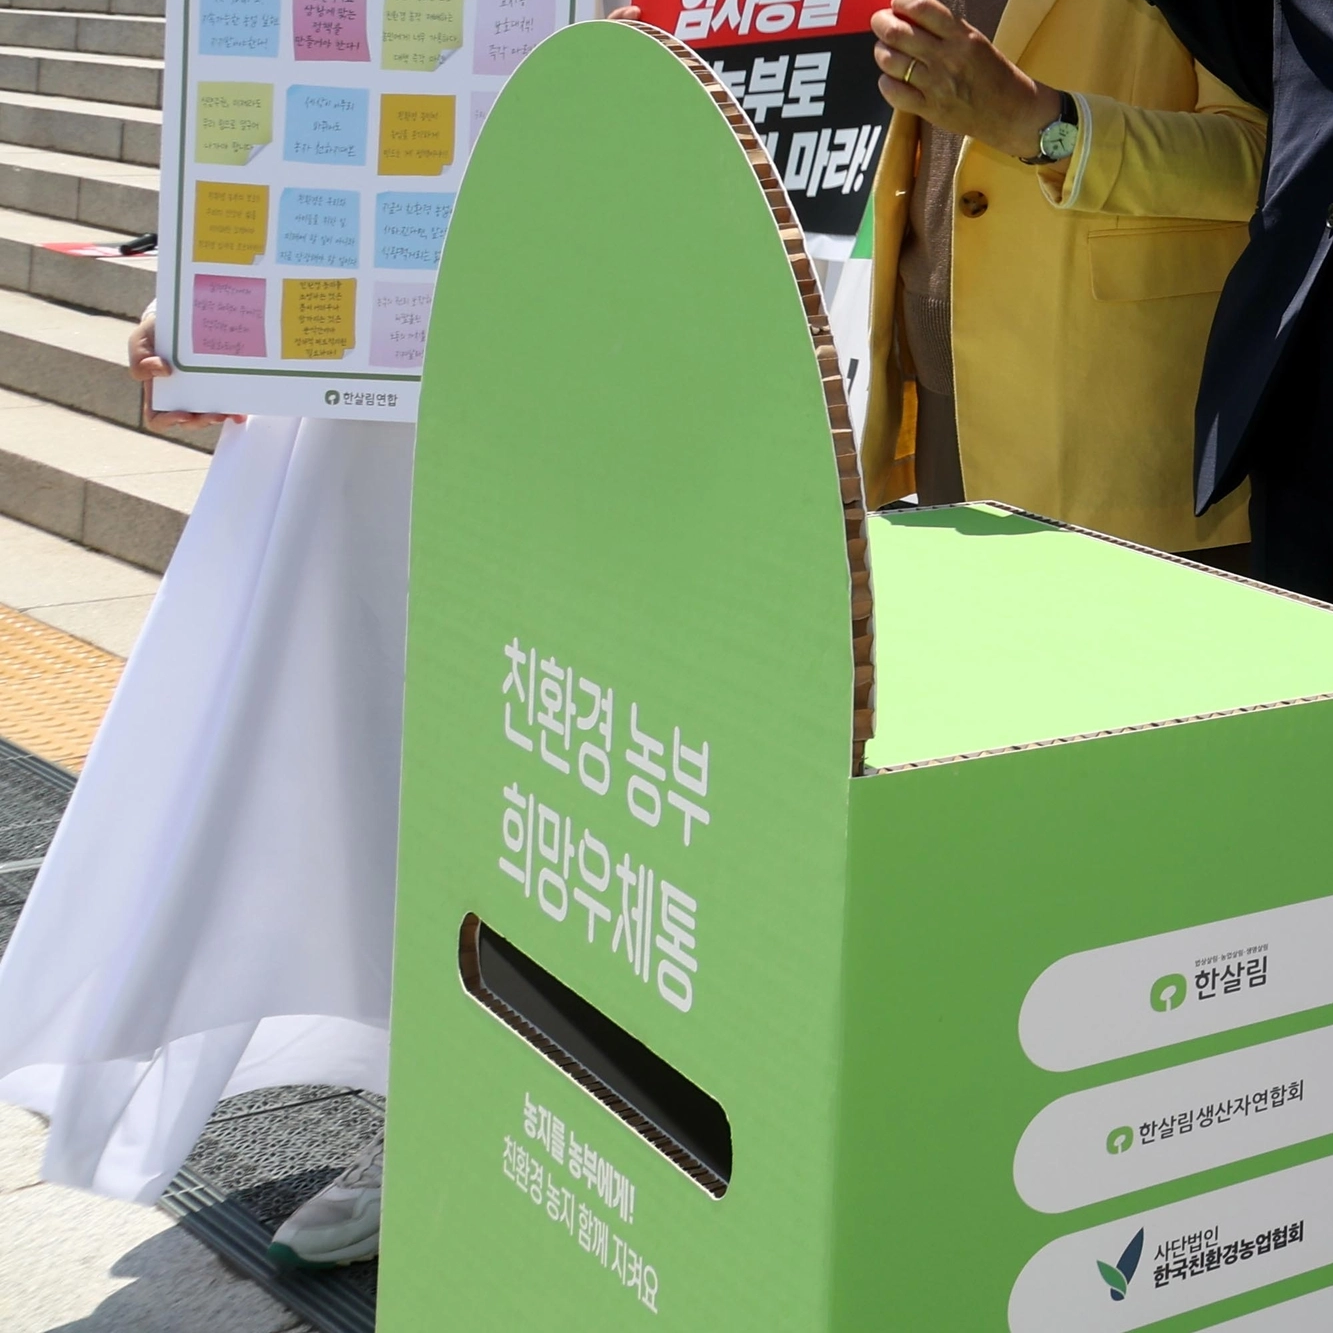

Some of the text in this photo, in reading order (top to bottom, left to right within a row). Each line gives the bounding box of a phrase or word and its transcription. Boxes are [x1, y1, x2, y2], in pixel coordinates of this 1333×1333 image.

[784, 124, 882, 197] 마라!
[343, 390, 398, 408] 한살림연합
[503, 637, 710, 846] 친환경 농부
[499, 782, 698, 1013] 희망우체통
[1194, 955, 1268, 1001] 한살림
[1139, 1080, 1304, 1144] 한살림생산자연합회
[524, 1092, 635, 1224] 농지를 농부에게!
[503, 1135, 658, 1314] 친환경 농지 함께 지켜요
[1153, 1221, 1304, 1289] 한국친환경농업협회
[1154, 1226, 1220, 1263] 사단법인
